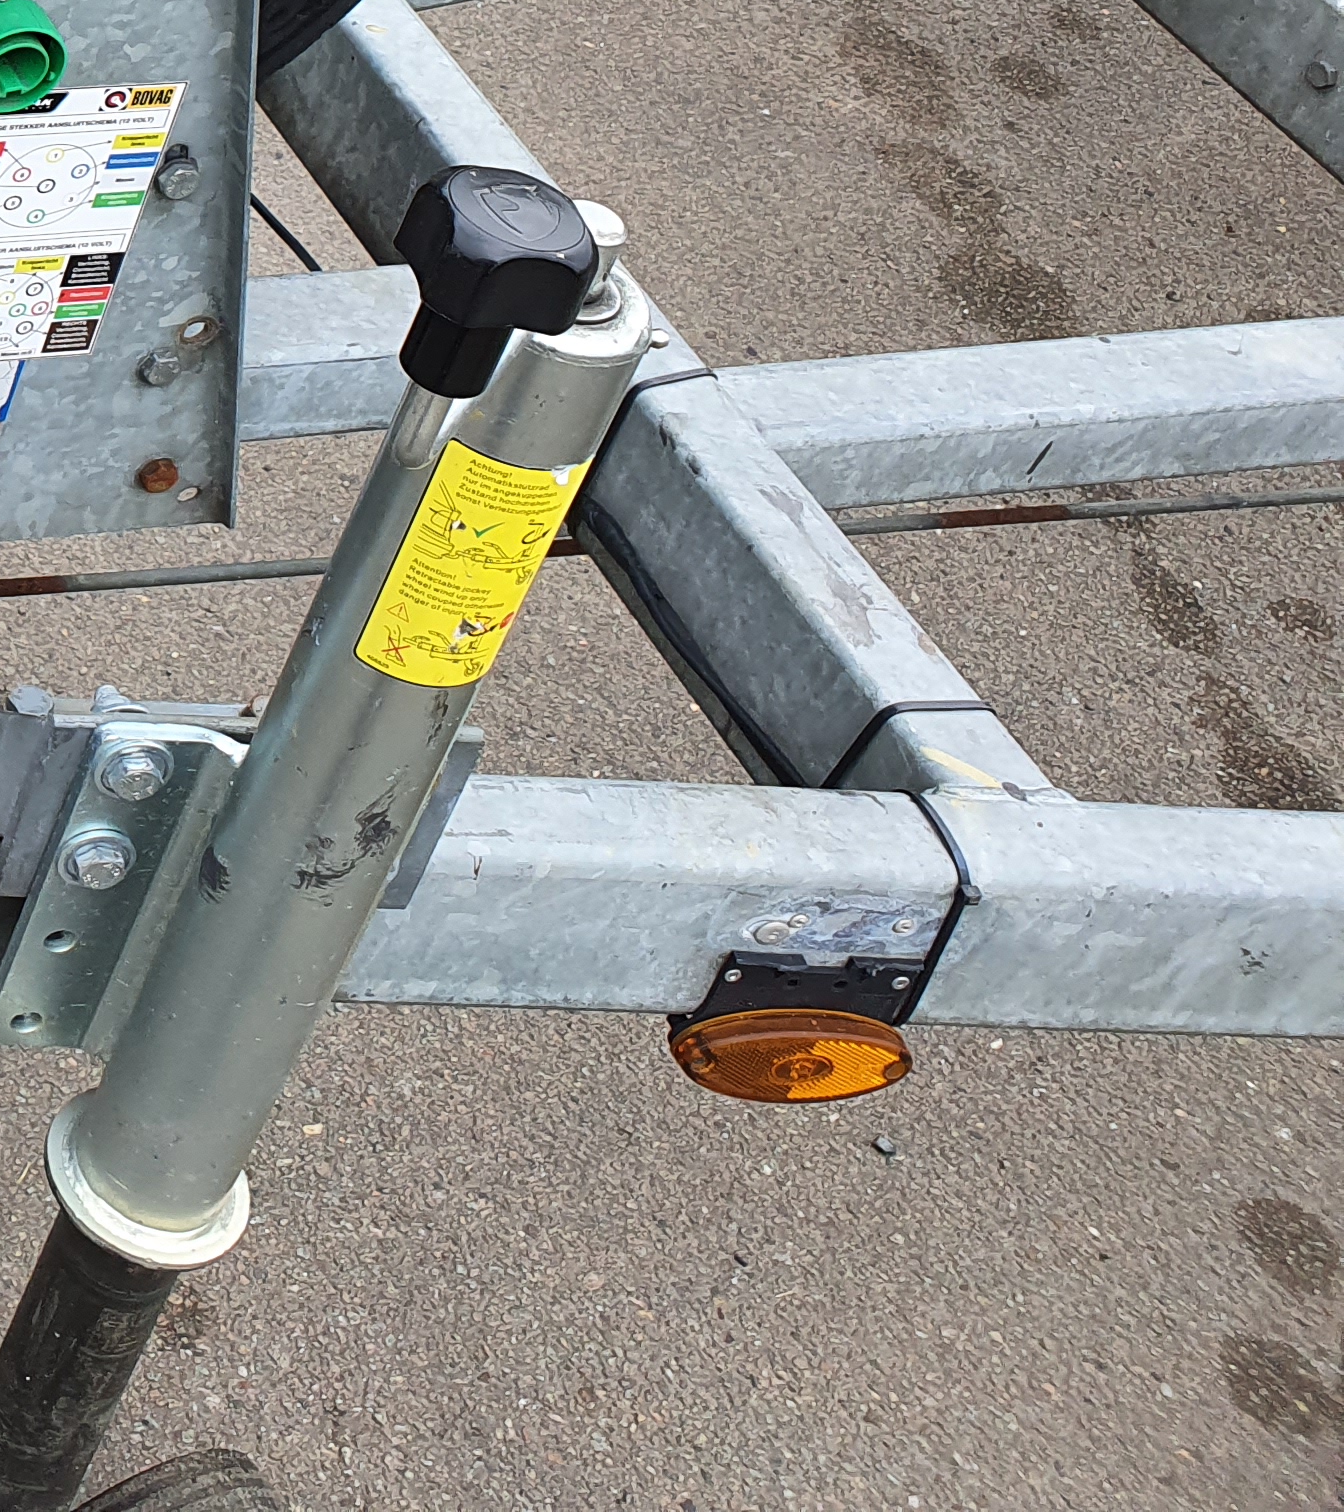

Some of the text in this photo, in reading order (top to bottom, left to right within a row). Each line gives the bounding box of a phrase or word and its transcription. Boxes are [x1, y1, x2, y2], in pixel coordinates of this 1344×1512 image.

[131, 89, 174, 106] BOVAG
[9, 123, 45, 131] STEKKER
[47, 119, 117, 128] AANSLUITSCHEMA
[8, 244, 76, 253] AANSLUITSCHEMA
[470, 459, 512, 479] Achtung!
[458, 482, 497, 502] Zustand
[462, 475, 478, 486] nur
[480, 481, 491, 490] im
[455, 491, 481, 506] sonst
[412, 557, 457, 580] Attention!
[405, 573, 488, 603] wheel wind up only
[409, 565, 491, 595] Retractable jockey
[398, 589, 429, 606] danger
[430, 603, 441, 611] of
[402, 581, 425, 596] when
[426, 592, 463, 607] coupled
